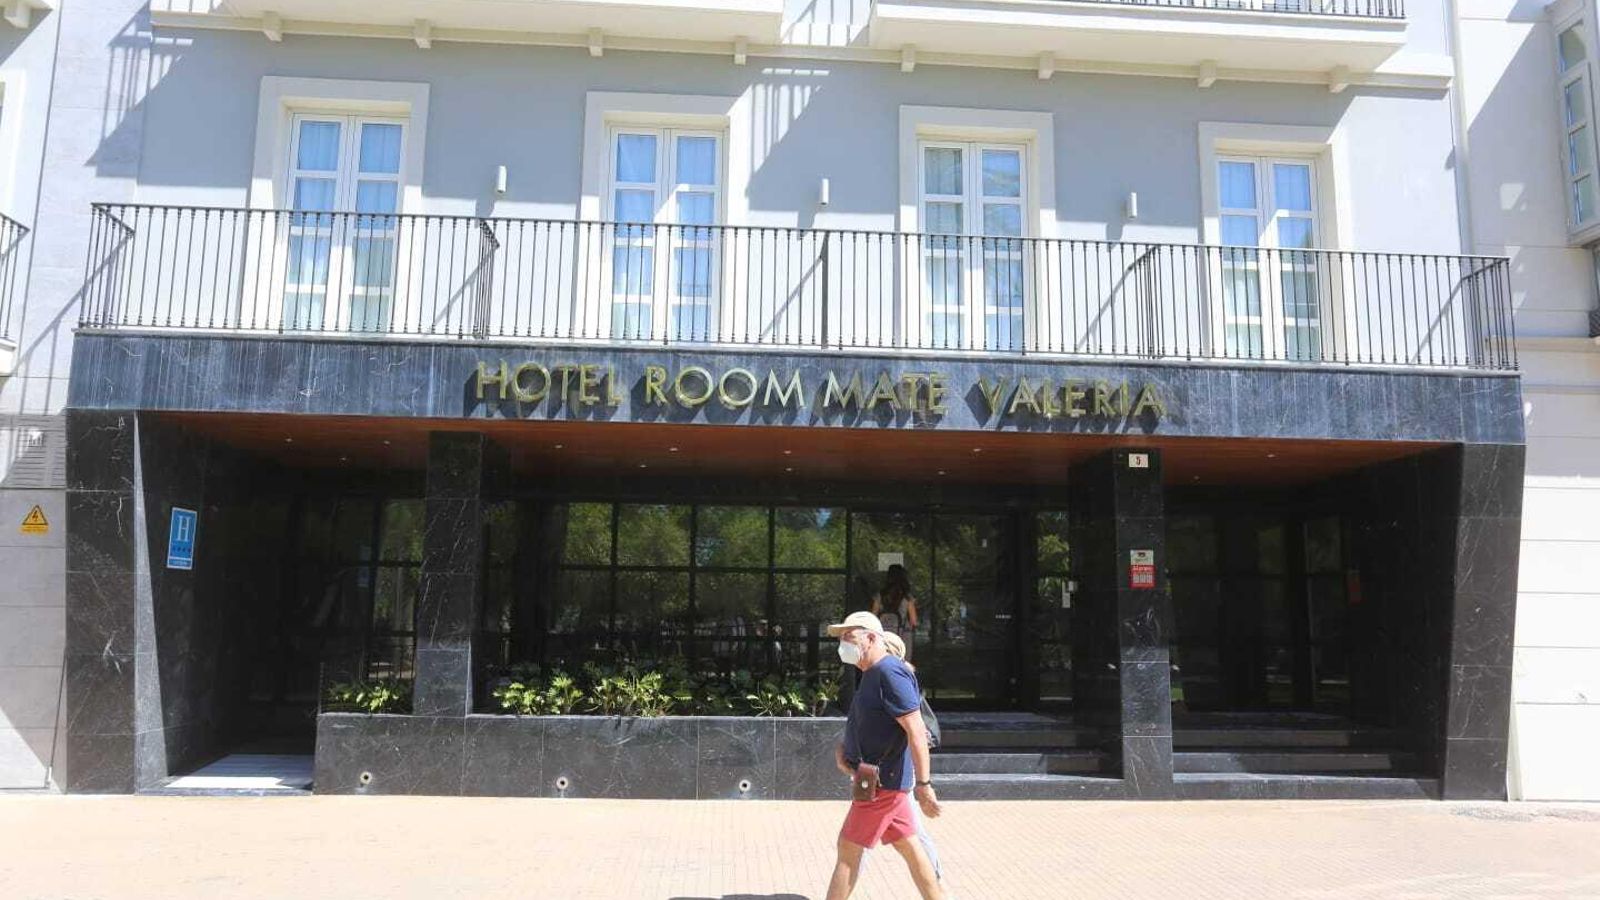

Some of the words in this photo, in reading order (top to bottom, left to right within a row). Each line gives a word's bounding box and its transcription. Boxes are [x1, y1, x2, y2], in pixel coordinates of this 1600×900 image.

[475, 358, 623, 407] HOTEL
[645, 363, 806, 410] ROOM
[822, 368, 949, 415] MATE
[979, 374, 1168, 418] VALERIA
[176, 515, 191, 541] H
